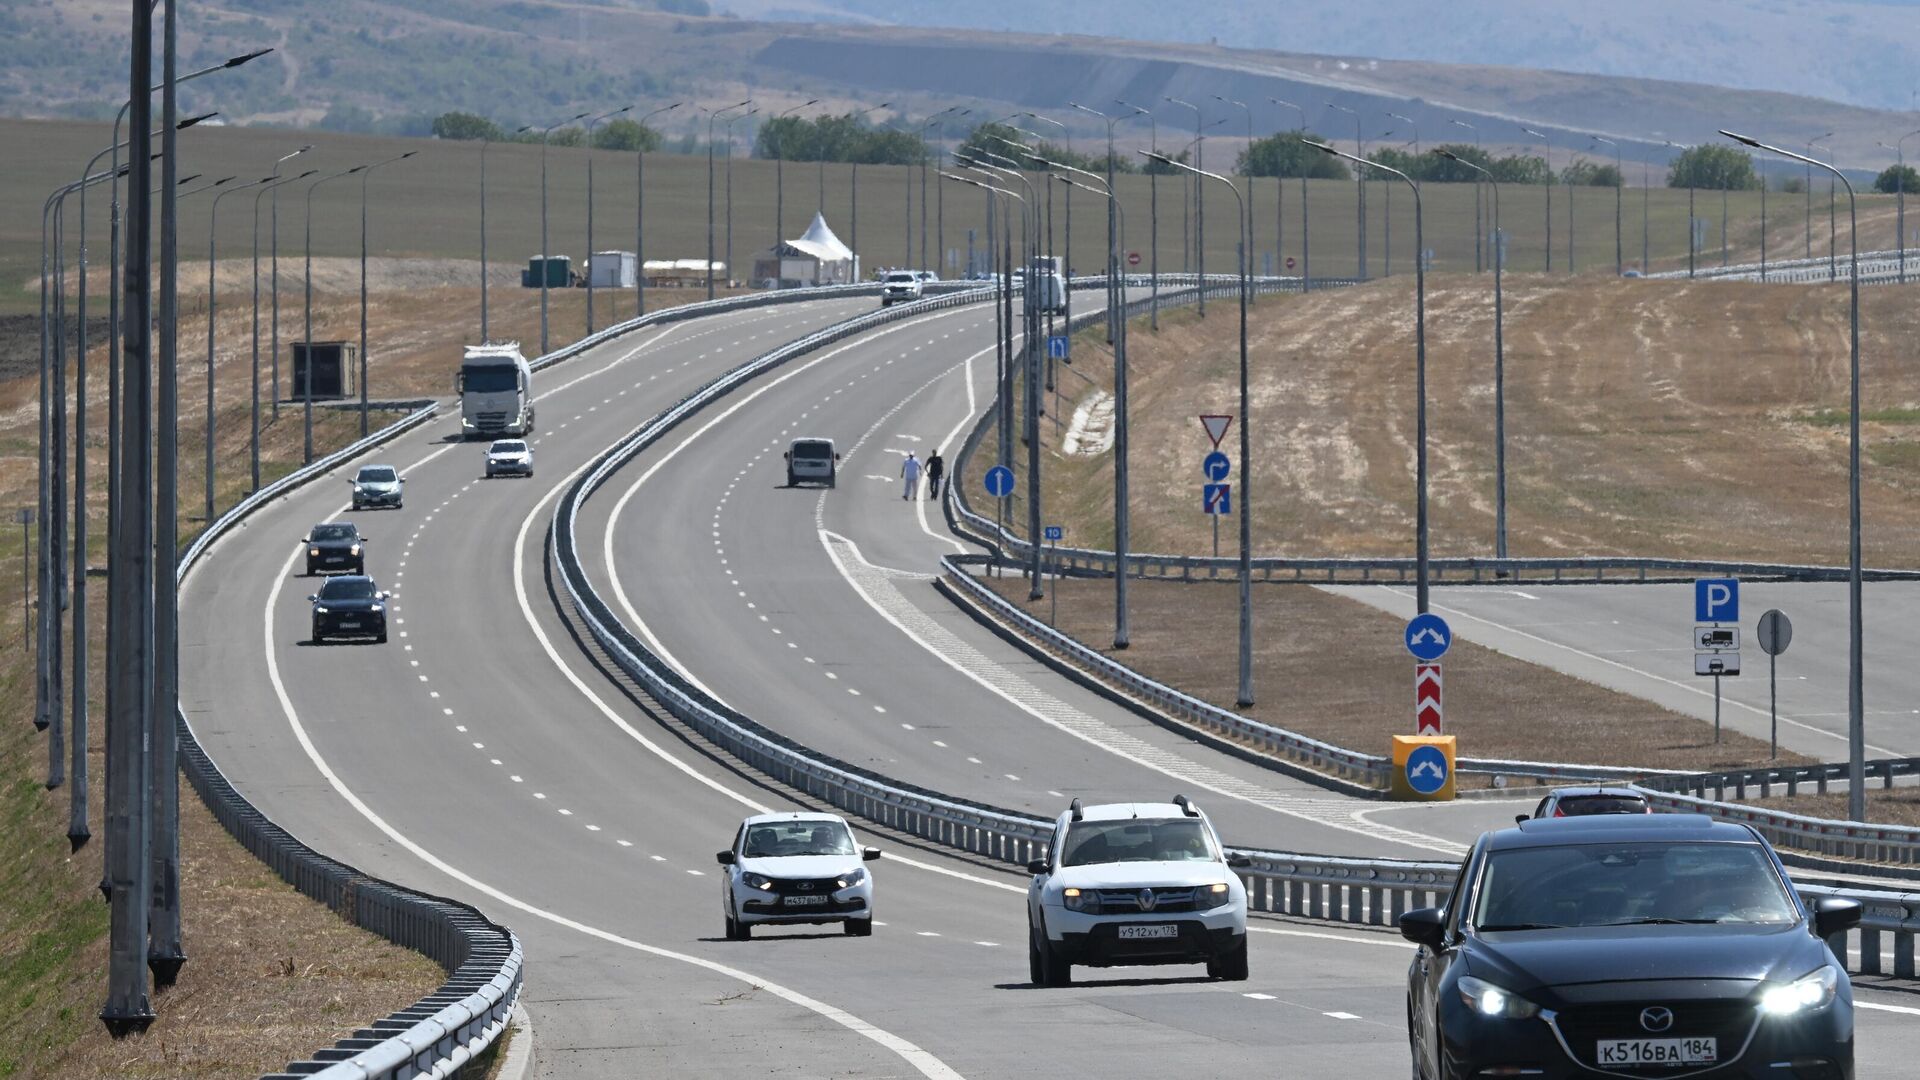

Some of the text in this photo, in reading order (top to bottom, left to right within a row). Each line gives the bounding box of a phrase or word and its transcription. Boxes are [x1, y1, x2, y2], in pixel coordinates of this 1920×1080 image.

[1047, 528, 1060, 538] 10
[1707, 583, 1731, 618] P
[1603, 1039, 1712, 1062] К516ВА 184
